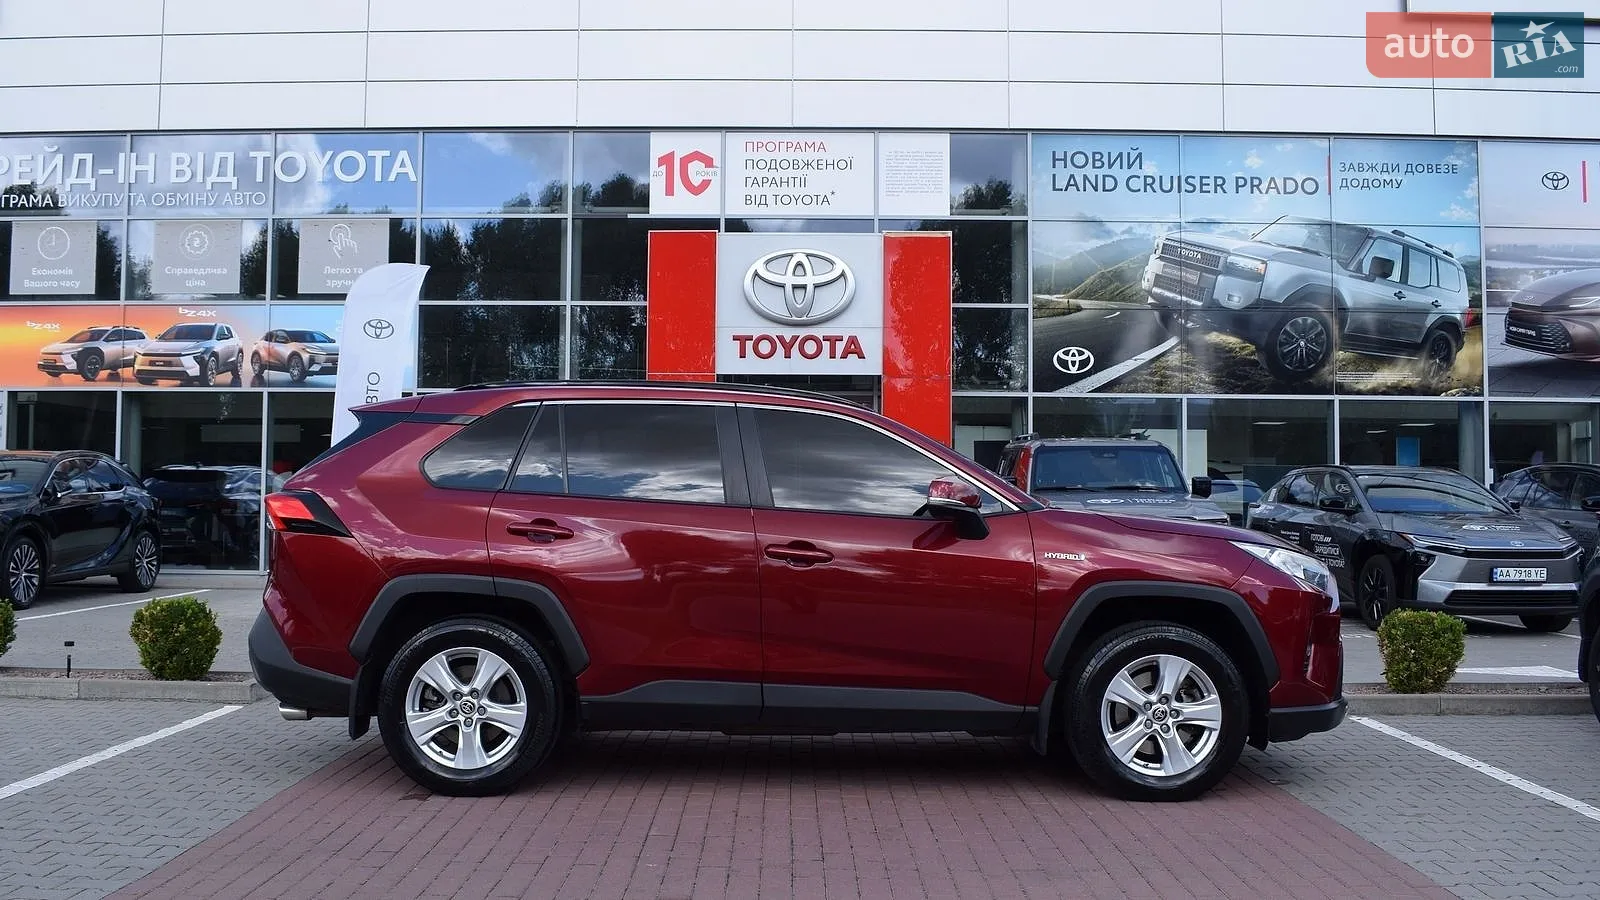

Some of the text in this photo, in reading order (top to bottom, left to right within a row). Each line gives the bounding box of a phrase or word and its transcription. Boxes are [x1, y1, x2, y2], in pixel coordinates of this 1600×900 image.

[745, 141, 827, 153] ПРОГРАМА
[744, 156, 854, 171] ПОДОВЖЕНОЇ
[1051, 147, 1144, 170] НОВИЙ
[171, 151, 238, 190] ВІД
[249, 149, 418, 183] TOYOTA
[1339, 161, 1459, 176] ЗАВЖДИ ДОВЕЗЕ
[744, 173, 808, 189] ГАРАНТІЇ
[1051, 173, 1320, 196] LAND CRUISER PRADO
[1339, 177, 1403, 191] ДОДОМУ
[58, 192, 124, 207] ВИКУПУ
[128, 192, 148, 206] ТА
[152, 192, 216, 206] ОБМІНУ
[223, 191, 266, 206] АВТО
[744, 194, 768, 208] ВІД
[1178, 248, 1201, 259] TOYOTA
[32, 267, 73, 276] Економія
[164, 266, 228, 276] Справедлива
[323, 266, 350, 274] Легко
[24, 280, 80, 288] Вашого часу
[732, 334, 866, 360] TOYOTA
[1044, 552, 1081, 560] HYBRID
[1498, 570, 1545, 578] AA 7918 YE
